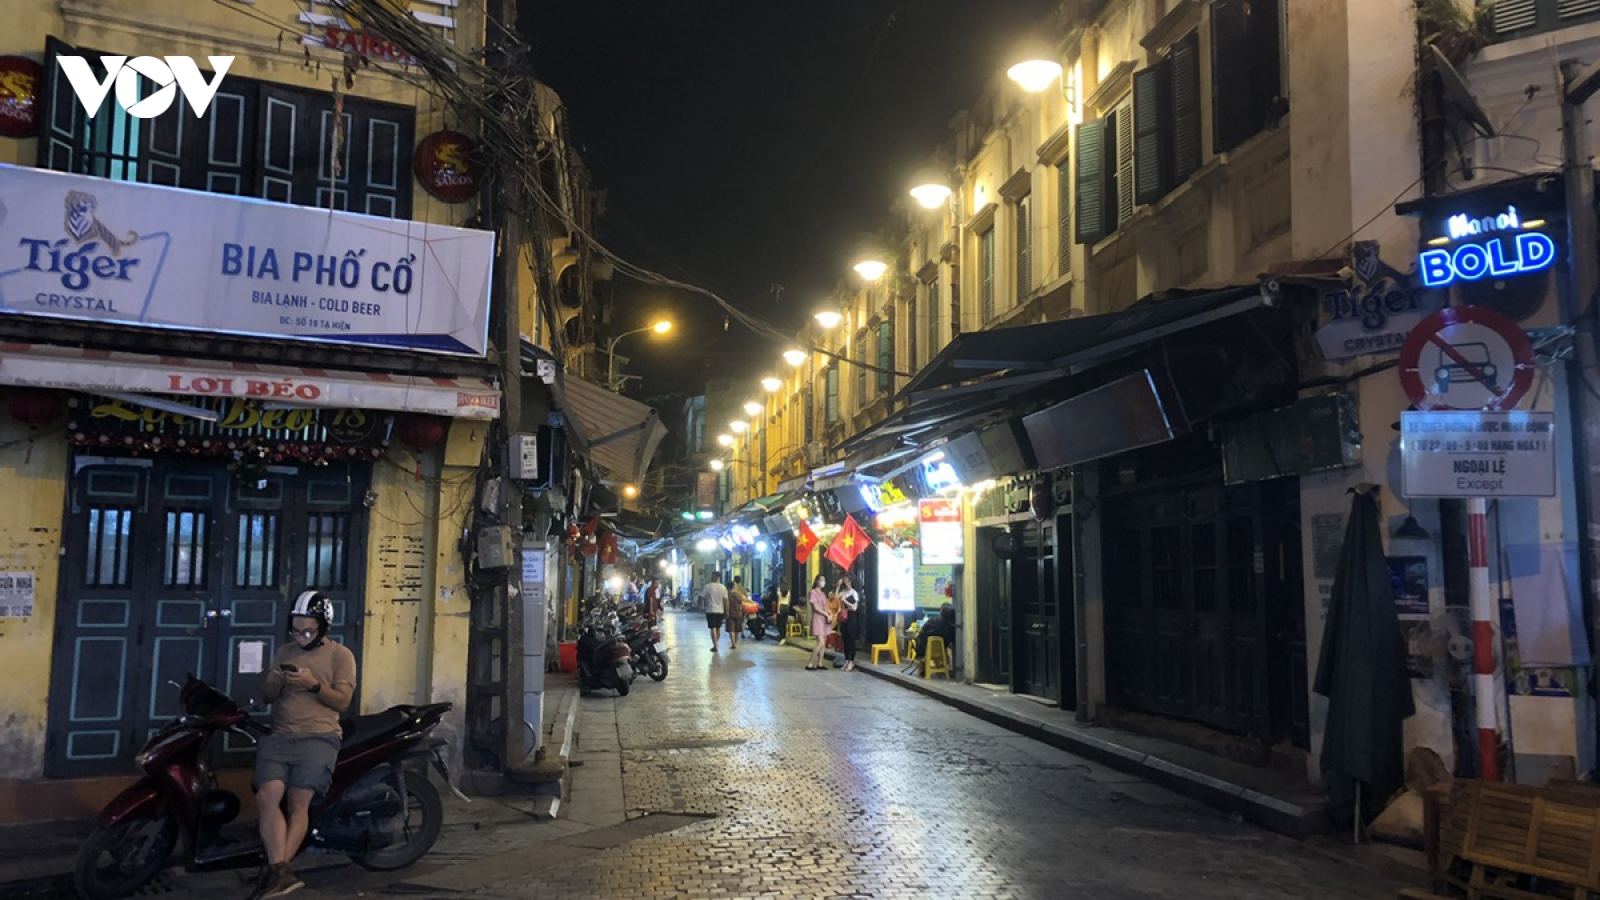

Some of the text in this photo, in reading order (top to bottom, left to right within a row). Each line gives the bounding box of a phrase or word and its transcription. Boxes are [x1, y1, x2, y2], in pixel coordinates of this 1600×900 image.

[1448, 204, 1518, 239] Hanoi
[221, 242, 416, 295] BIA PHỐ CỔ
[1419, 232, 1555, 286] BOLD
[35, 292, 118, 313] CRYSTAL
[251, 290, 273, 305] BIA
[275, 292, 308, 309] LẠNH
[319, 297, 349, 313] COLD
[352, 300, 381, 316] BEER
[1344, 331, 1413, 353] CRYSTA
[245, 377, 321, 400] BÉO
[1453, 456, 1507, 476] NGOẠI LỆ
[1456, 476, 1504, 491] Except
